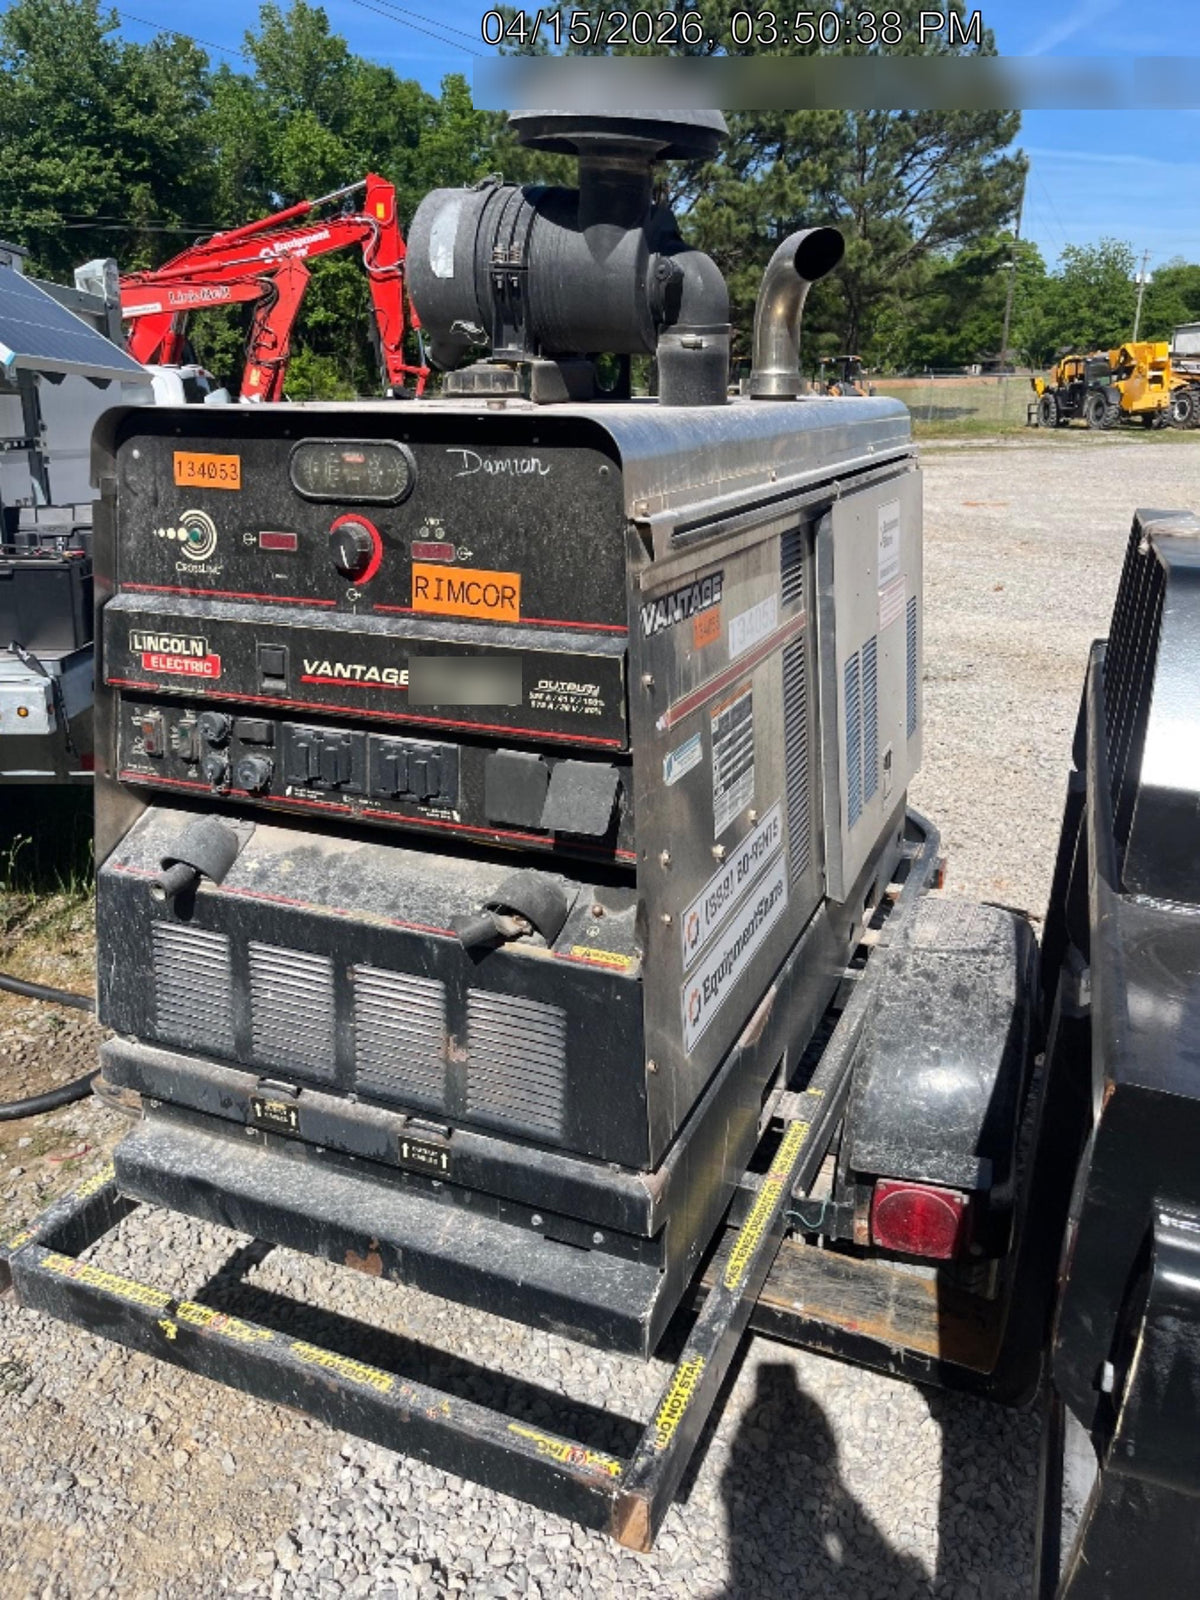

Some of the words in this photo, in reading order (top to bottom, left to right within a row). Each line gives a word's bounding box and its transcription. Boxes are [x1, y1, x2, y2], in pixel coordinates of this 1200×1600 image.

[176, 460, 240, 482] 134053
[415, 575, 517, 610] RIMCOR
[640, 574, 722, 637] VANTAGE
[133, 634, 205, 657] LINCOLN
[150, 657, 213, 674] ELECTRIC
[303, 658, 409, 685] VANTAGE
[724, 1263, 740, 1285] PAS
[654, 1419, 673, 1443] DO
[664, 1390, 686, 1420] NOT
[677, 1352, 702, 1389] STAN
